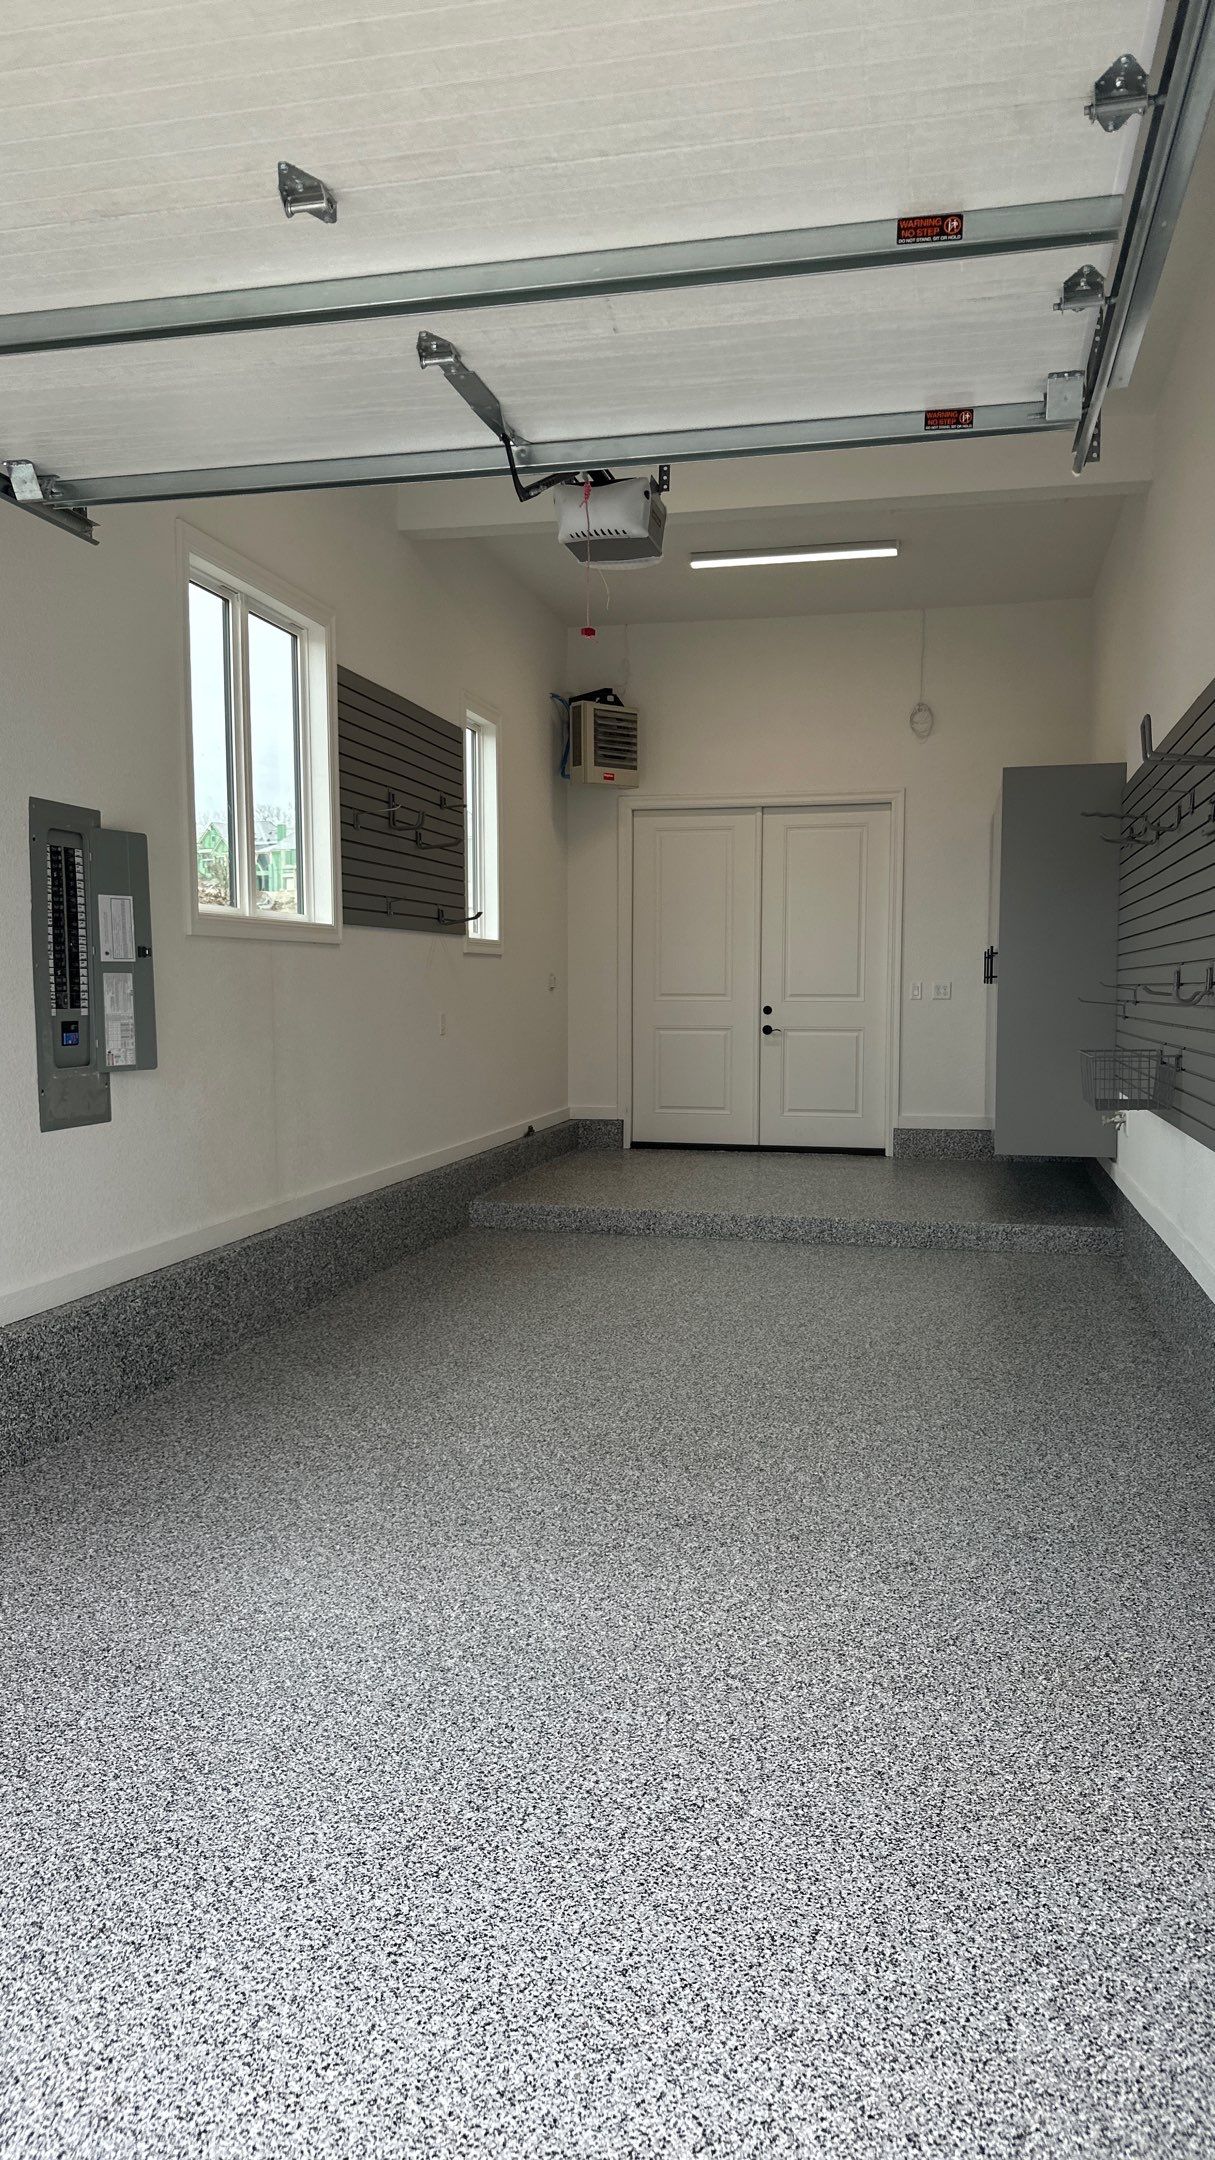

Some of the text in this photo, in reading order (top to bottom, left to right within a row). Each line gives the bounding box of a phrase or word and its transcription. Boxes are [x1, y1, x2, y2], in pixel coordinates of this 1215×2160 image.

[900, 217, 942, 228] WARNING
[901, 228, 940, 238] NO STEP
